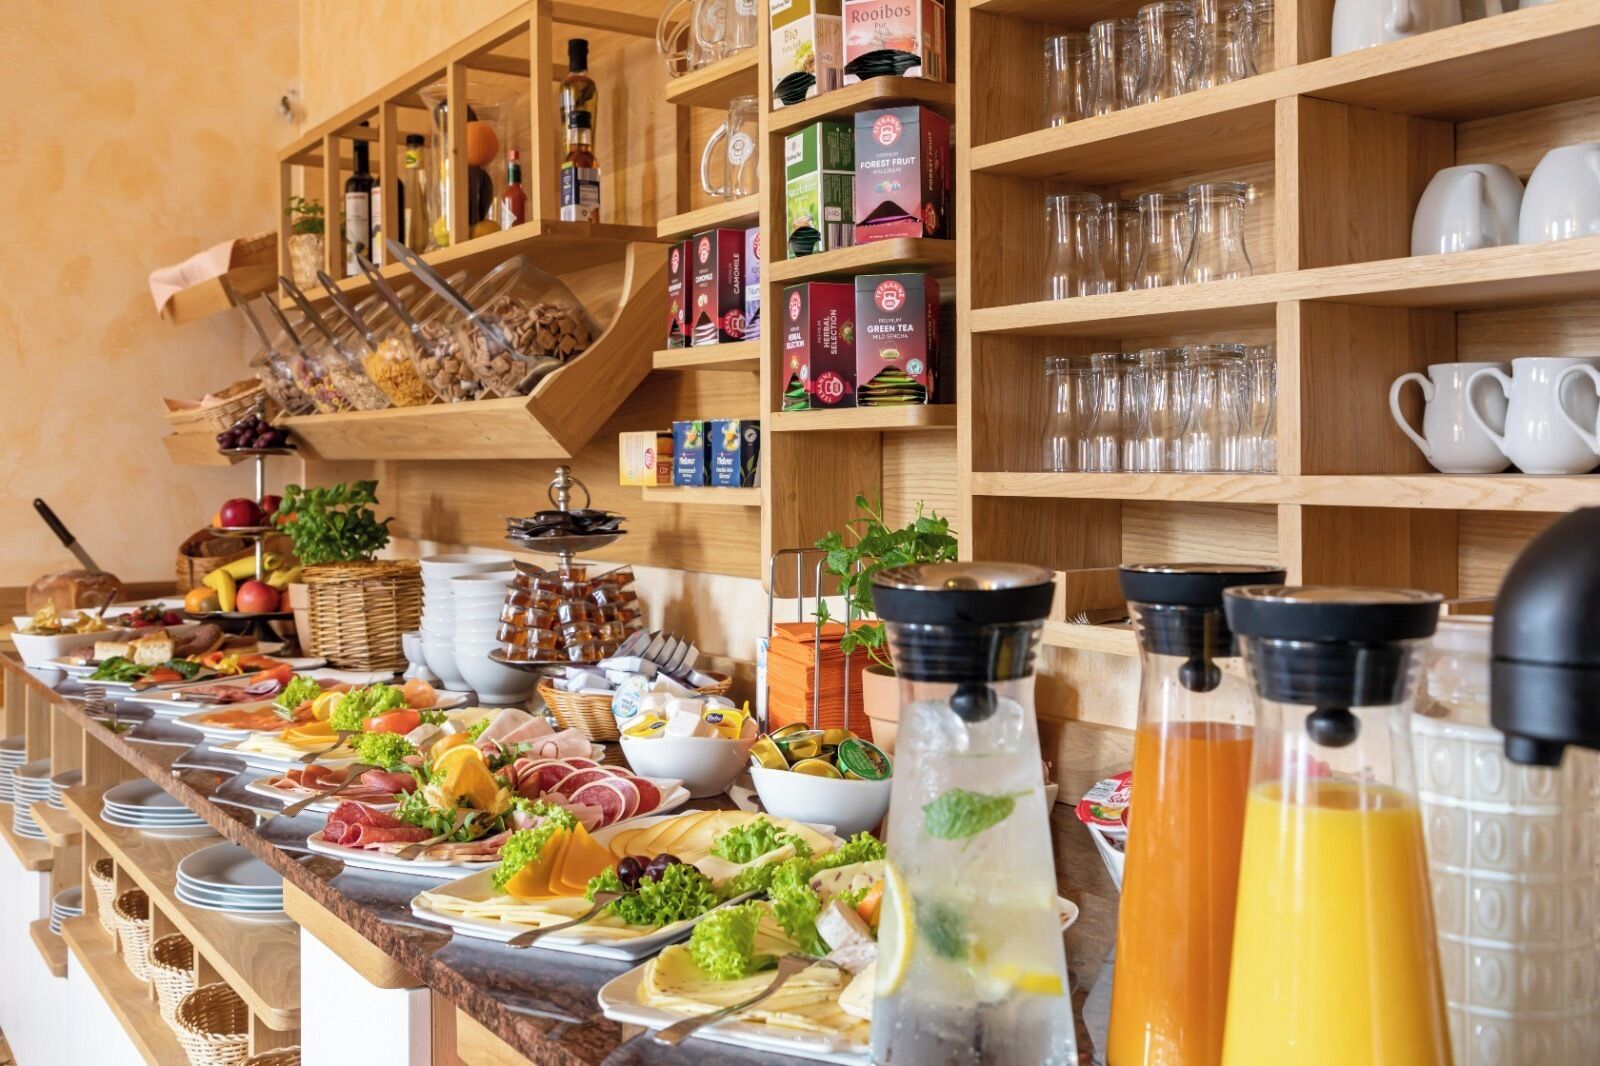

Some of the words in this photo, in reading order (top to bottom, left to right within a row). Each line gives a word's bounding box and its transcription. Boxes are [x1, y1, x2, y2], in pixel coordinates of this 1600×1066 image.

[851, 4, 911, 24] Rooibos
[860, 159, 890, 169] FOREST
[892, 156, 916, 166] FRUIT
[823, 316, 831, 349] HERBAL
[830, 309, 838, 355] SELECTION
[866, 324, 895, 333] GREEN
[897, 324, 914, 332] TEA
